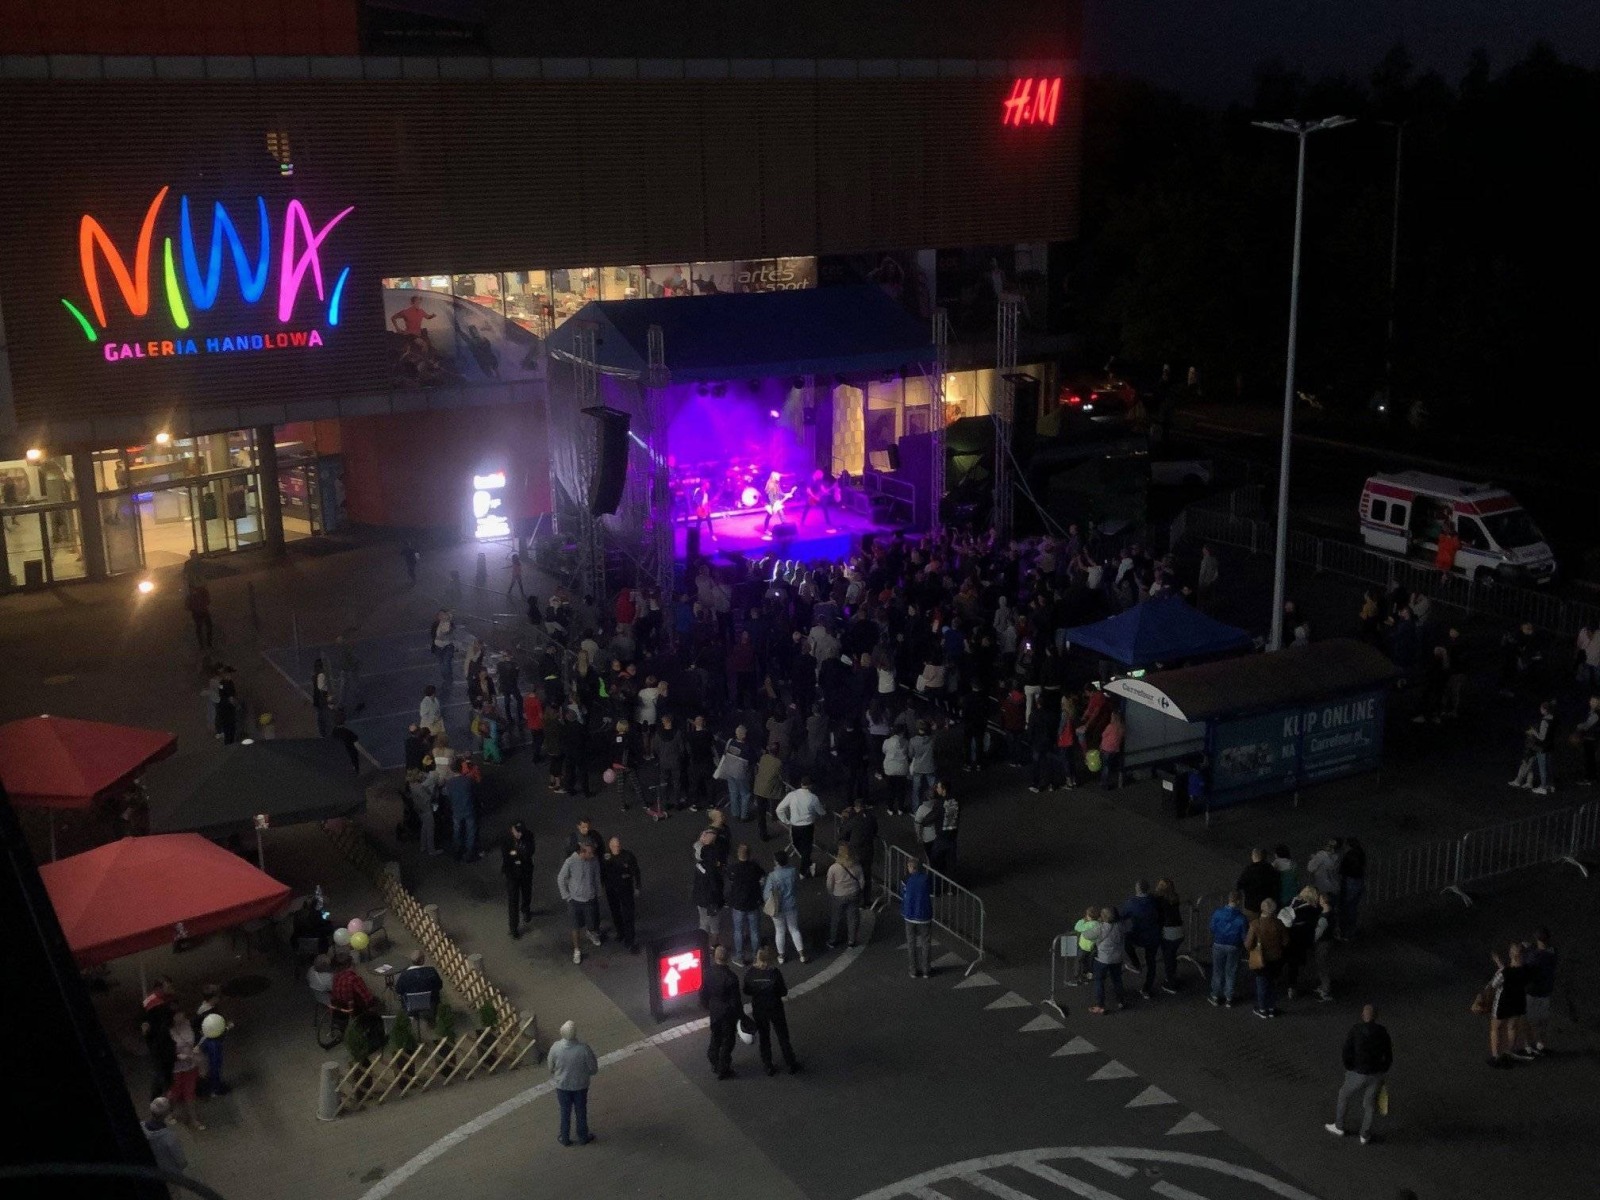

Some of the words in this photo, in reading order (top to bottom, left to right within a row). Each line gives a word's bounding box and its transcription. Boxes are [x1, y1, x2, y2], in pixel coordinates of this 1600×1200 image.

[1003, 77, 1061, 126] H&M
[79, 185, 354, 329] NIWA
[103, 339, 198, 362] GALERIA
[206, 329, 323, 353] HANDLOWA
[1322, 698, 1376, 729] ONLINE
